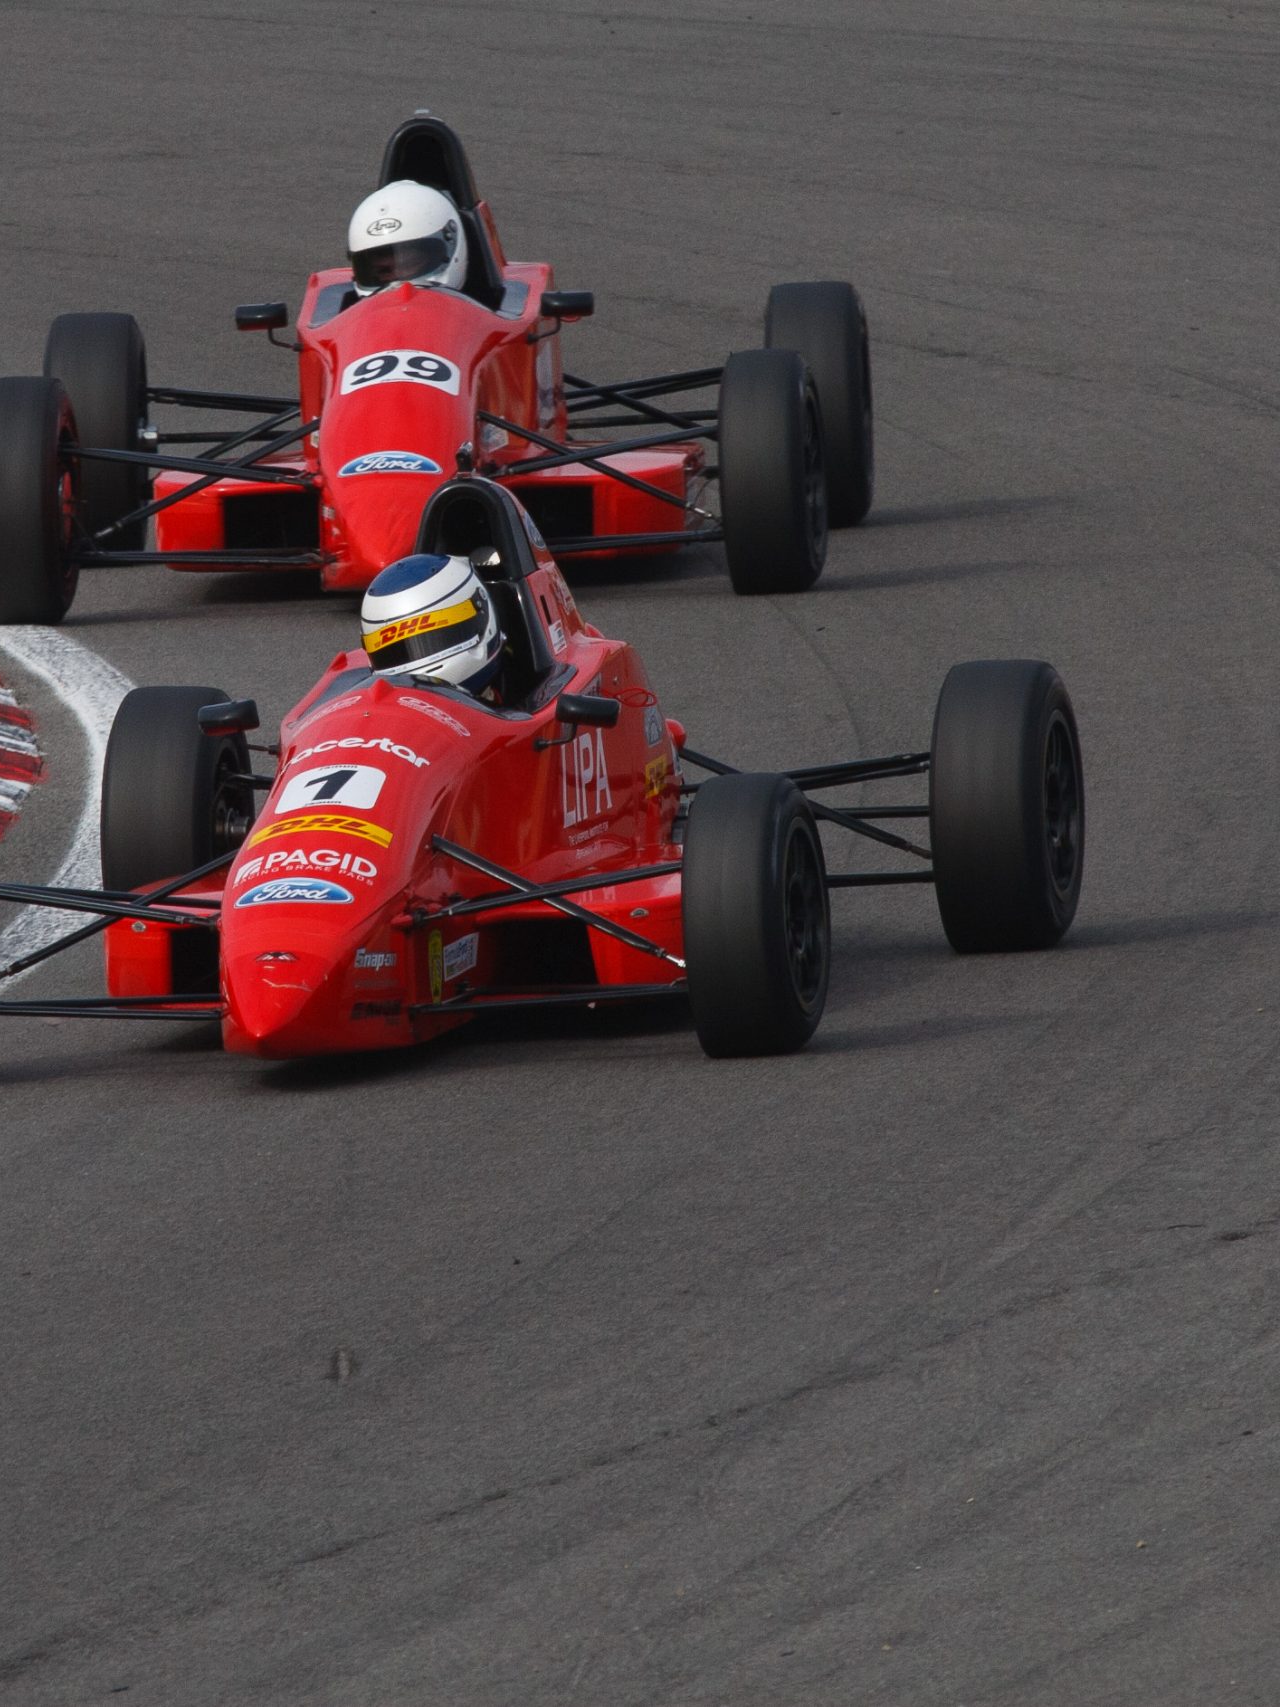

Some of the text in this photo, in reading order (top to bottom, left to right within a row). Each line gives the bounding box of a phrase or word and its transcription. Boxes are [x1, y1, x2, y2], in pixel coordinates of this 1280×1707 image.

[350, 355, 452, 386] 99
[355, 455, 422, 472] Ford
[378, 615, 436, 646] DHL
[304, 769, 358, 801] 1
[560, 727, 613, 828] LIPA
[267, 817, 372, 837] DHL
[265, 849, 378, 878] PAGID
[285, 864, 332, 873] BRAKE
[338, 869, 374, 886] PADS
[253, 883, 328, 902] Ford
